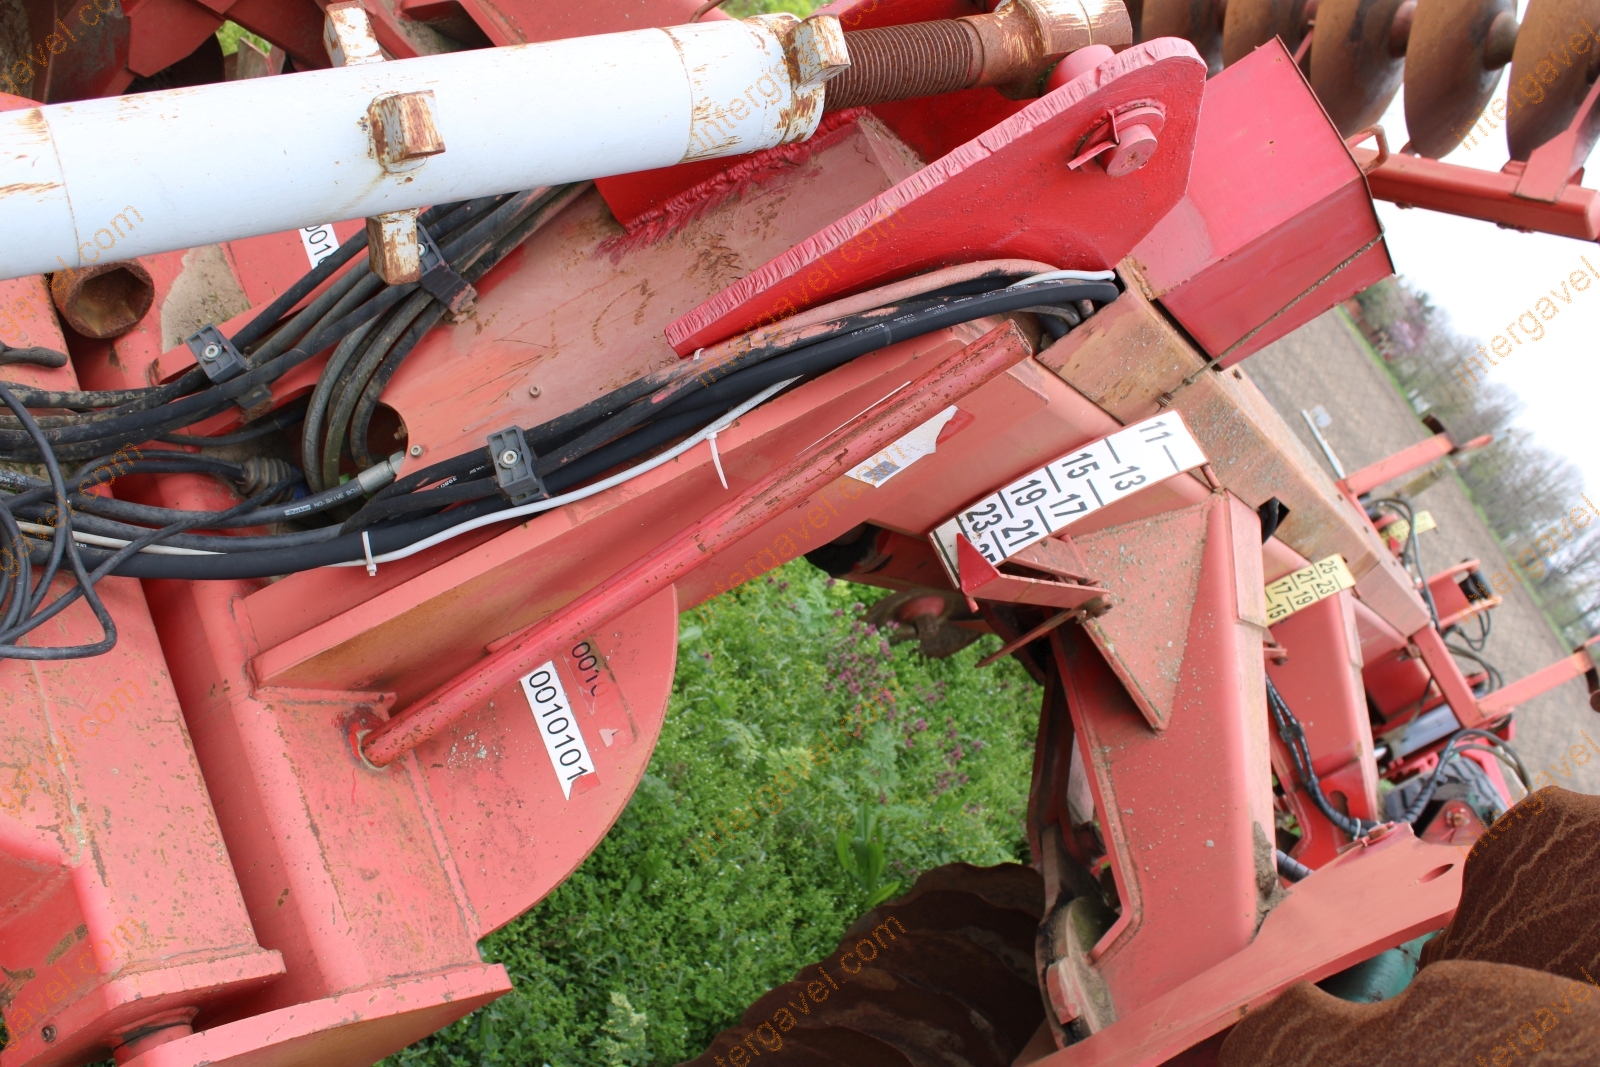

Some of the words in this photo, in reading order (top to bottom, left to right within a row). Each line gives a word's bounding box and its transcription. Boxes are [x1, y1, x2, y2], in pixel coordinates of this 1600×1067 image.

[1139, 421, 1174, 443] 11
[1062, 452, 1100, 480] 15
[1109, 465, 1147, 491] 13
[1010, 478, 1048, 507] 19
[1049, 493, 1089, 518] 17
[966, 503, 1003, 533] 23
[1001, 519, 1040, 548] 21
[1297, 570, 1318, 584] 21
[1319, 560, 1338, 574] 25
[1272, 581, 1293, 595] 17
[1293, 591, 1313, 606] 19
[1316, 580, 1336, 595] 23
[1266, 603, 1287, 619] 15
[529, 670, 588, 781] 0010101
